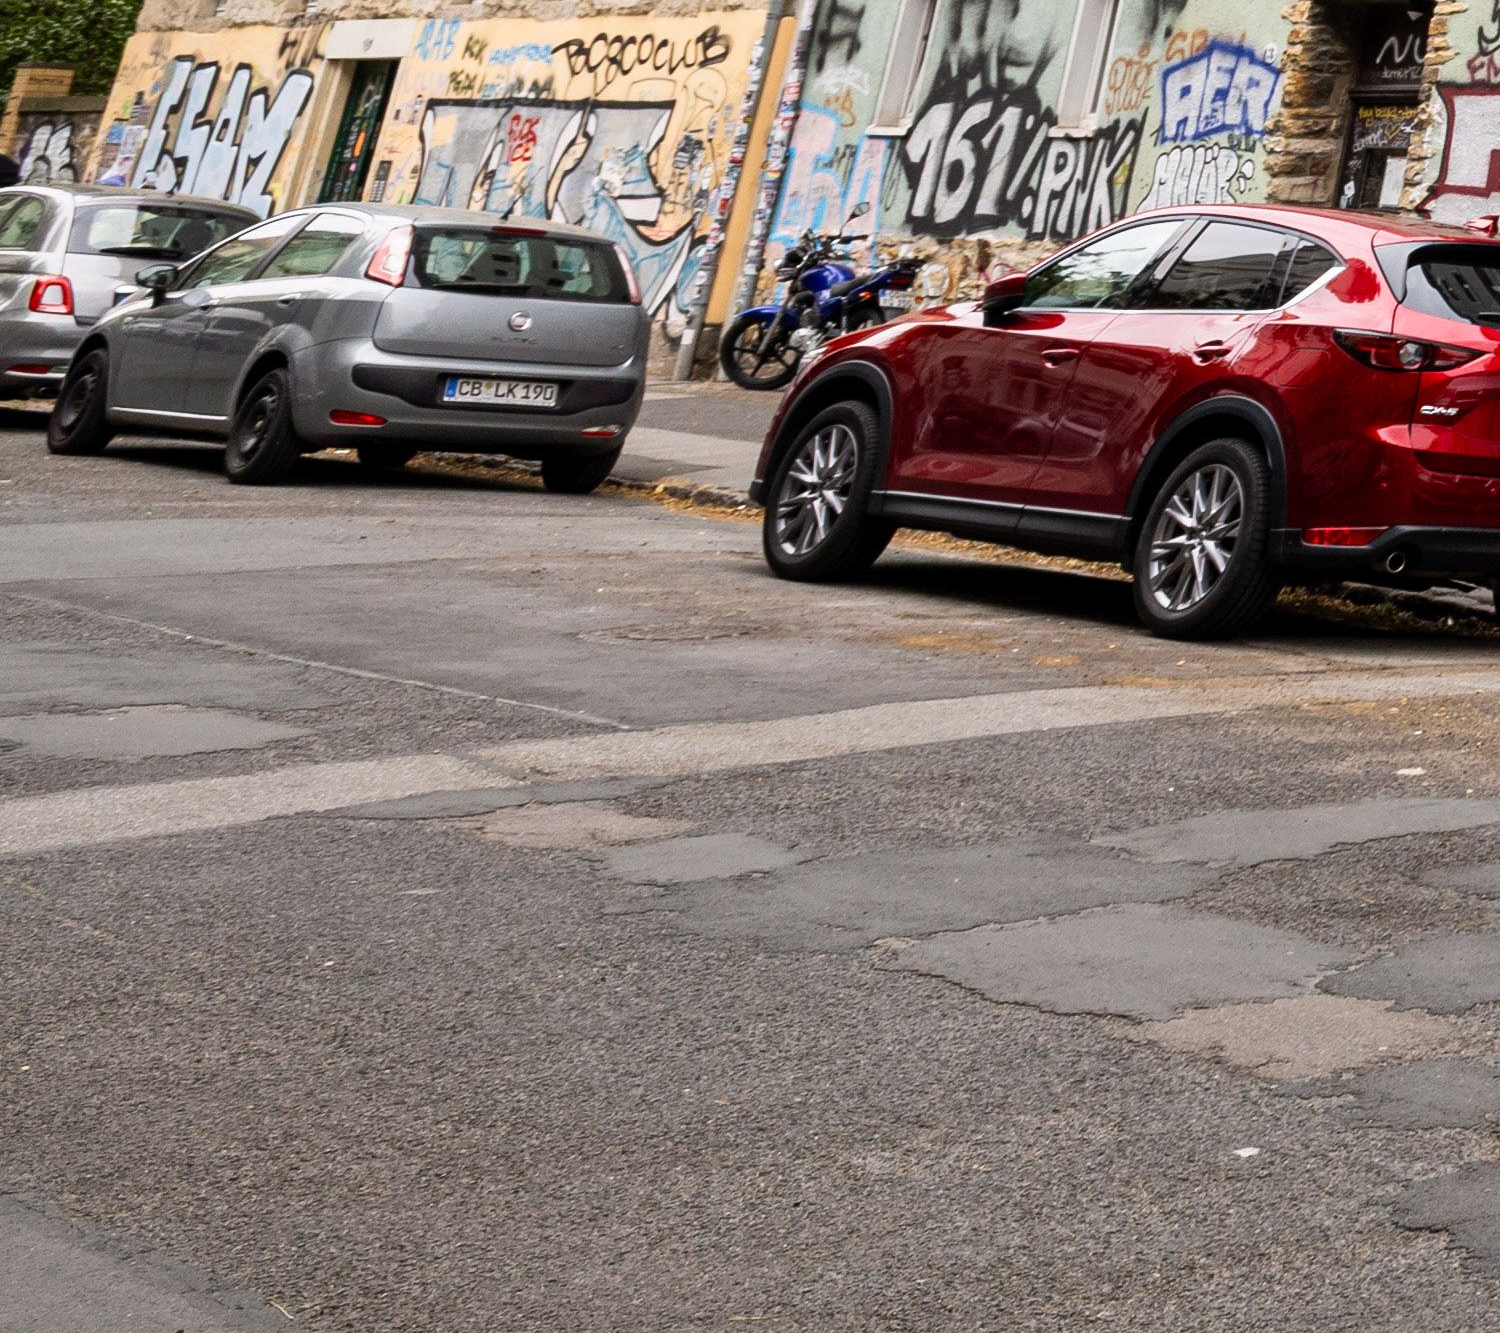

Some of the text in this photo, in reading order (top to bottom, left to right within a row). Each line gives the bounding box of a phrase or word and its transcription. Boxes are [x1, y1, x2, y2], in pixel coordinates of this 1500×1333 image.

[458, 380, 555, 401] CB LK 190
